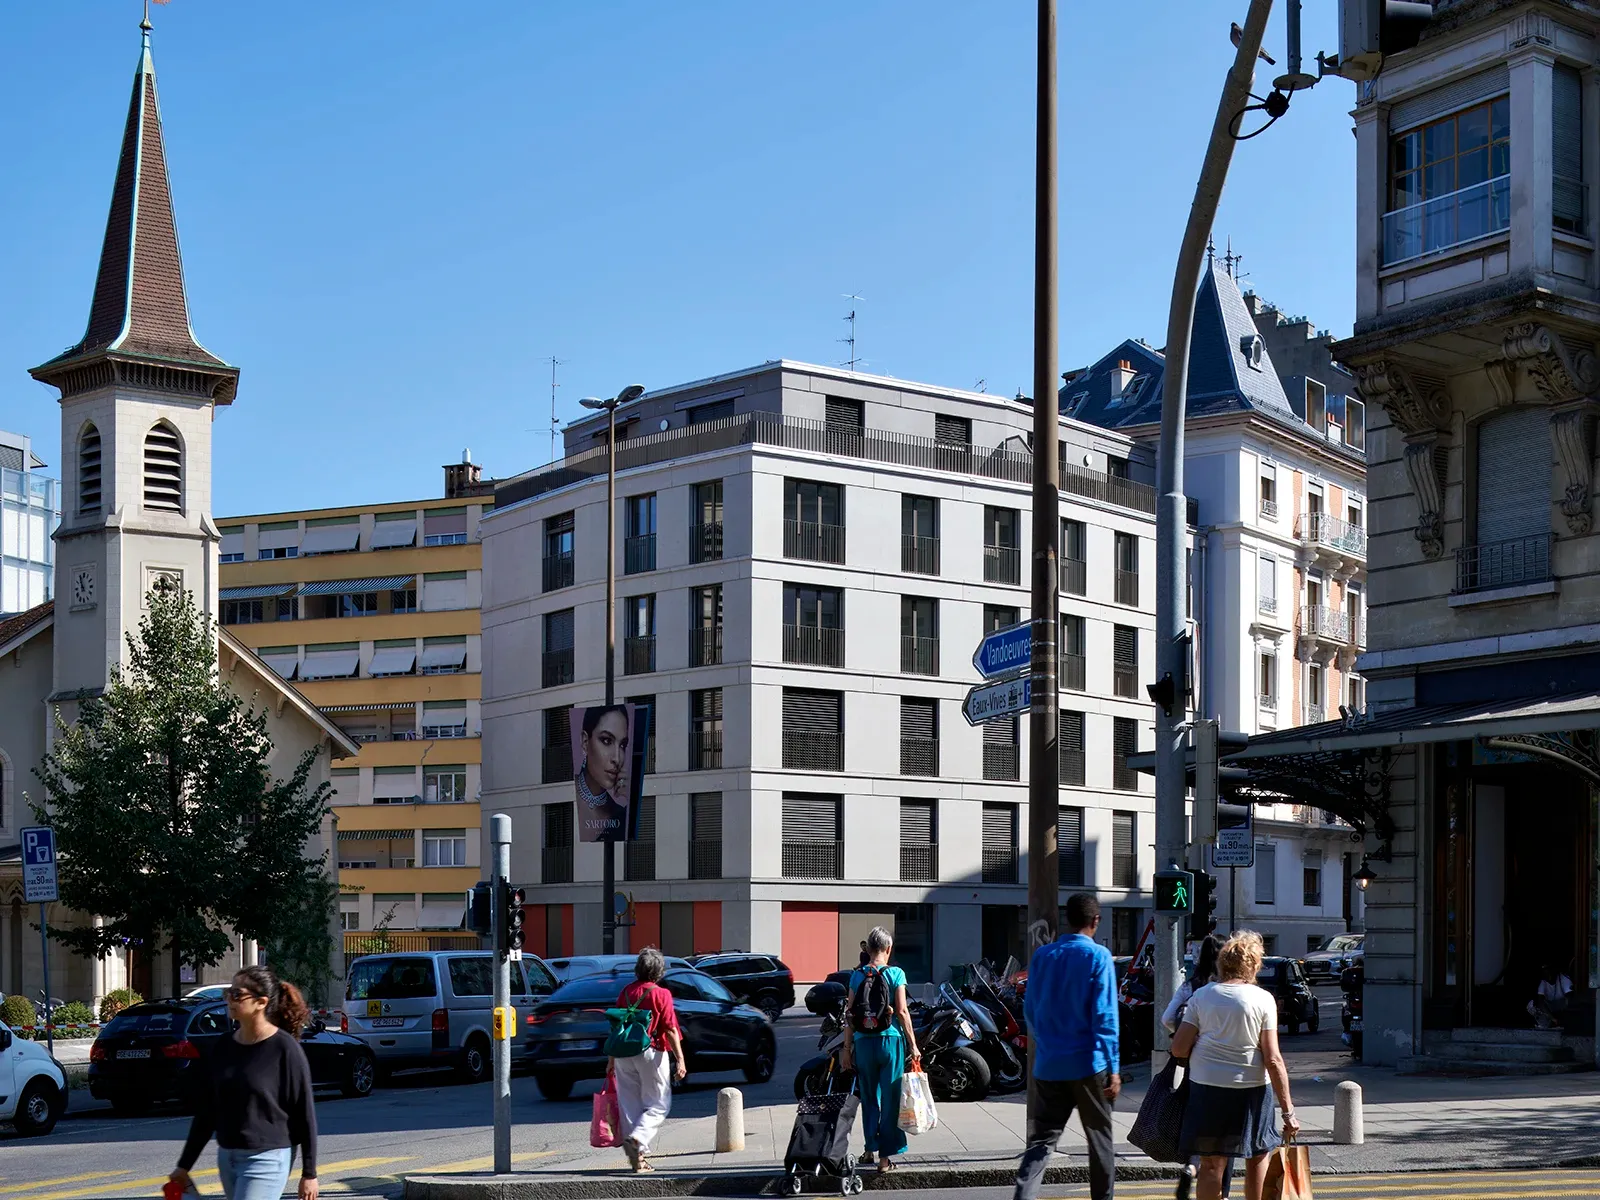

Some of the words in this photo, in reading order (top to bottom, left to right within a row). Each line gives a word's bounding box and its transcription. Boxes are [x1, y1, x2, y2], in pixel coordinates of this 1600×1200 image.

[986, 637, 1031, 666] Vandoeuvres
[972, 692, 1006, 716] Eaux-Vives
[585, 819, 621, 829] SARTORO
[26, 832, 38, 853] P
[1227, 840, 1238, 850] 90
[36, 875, 45, 885] 90
